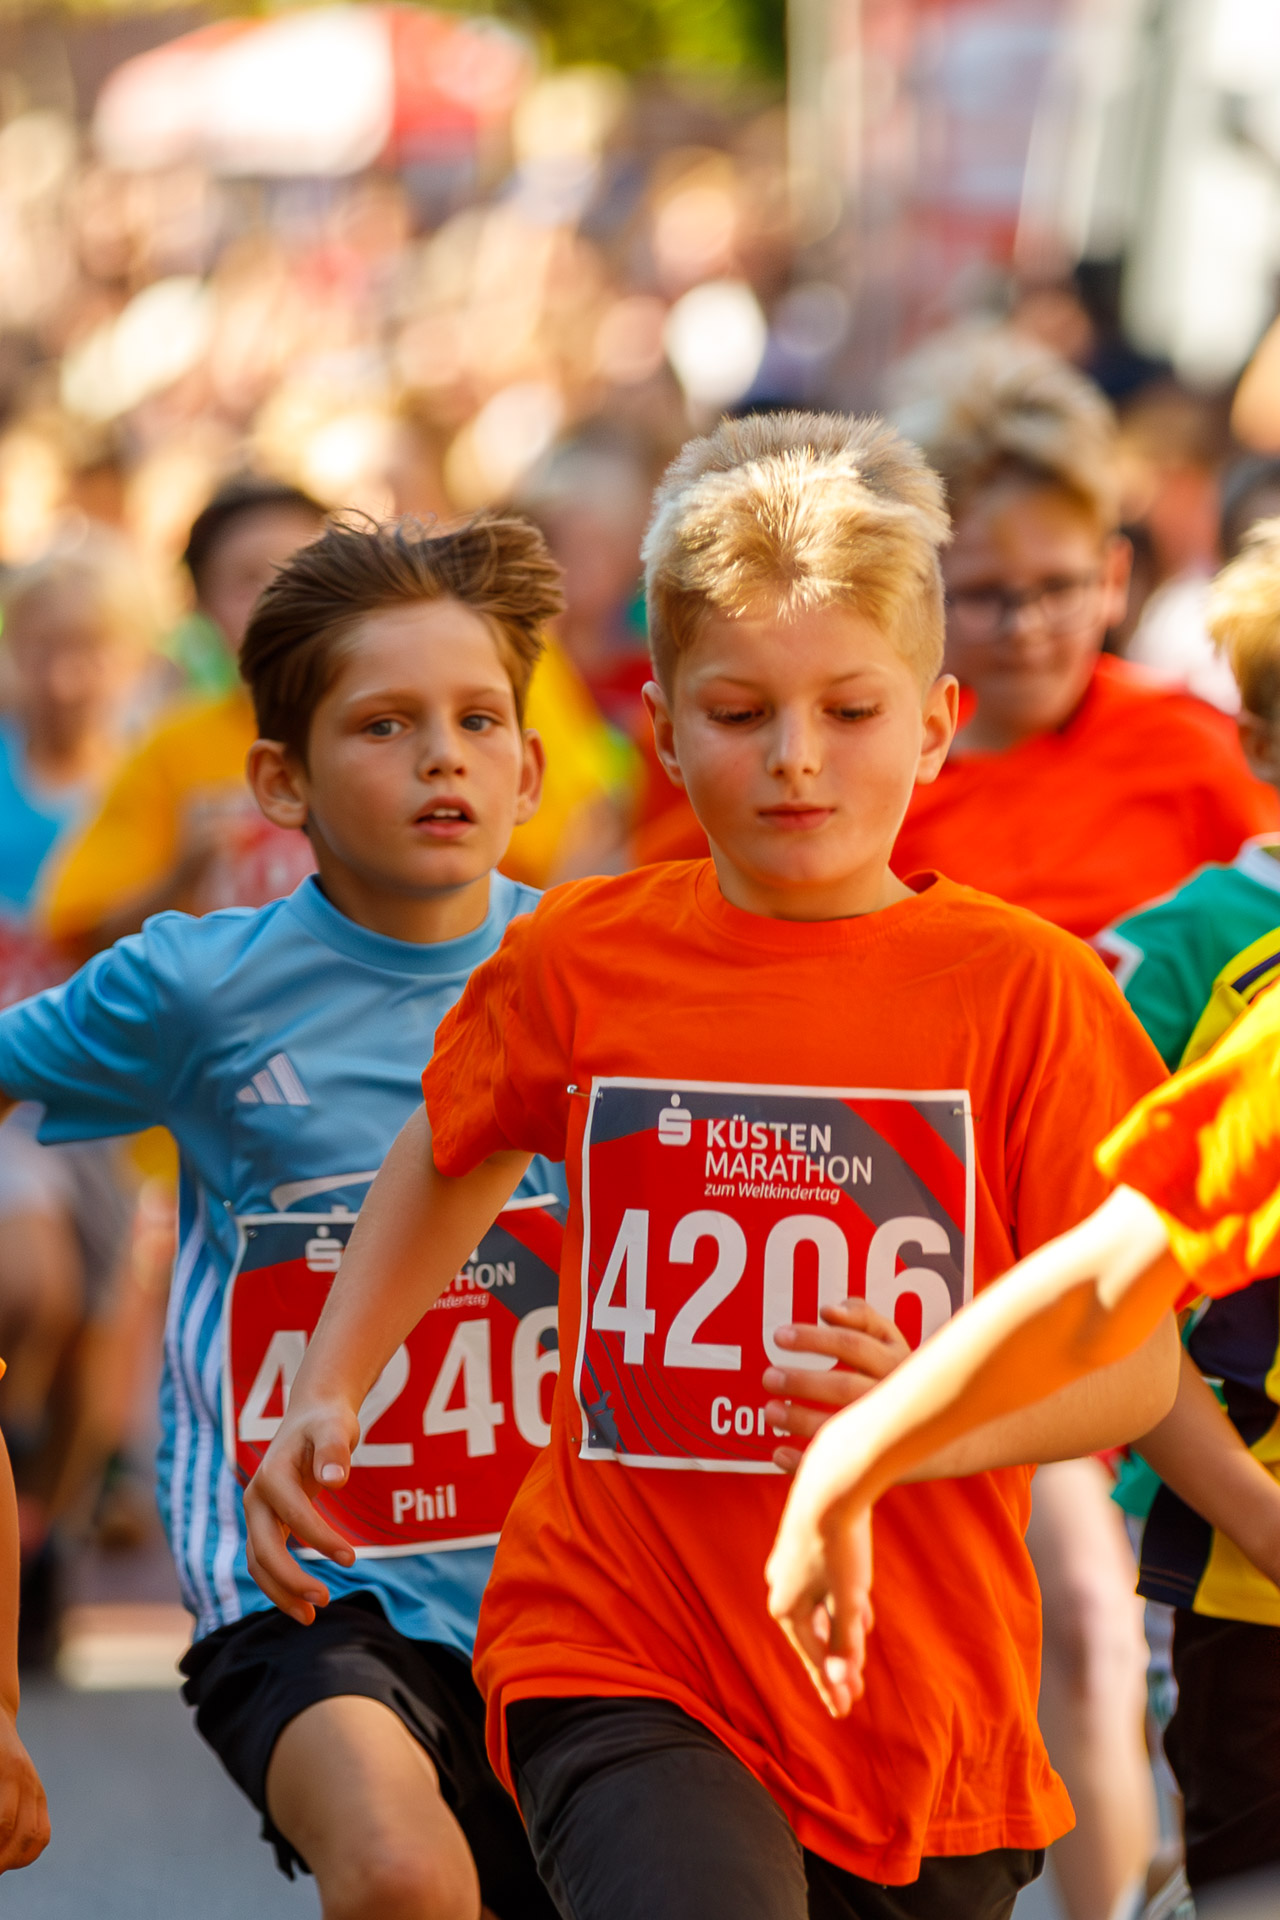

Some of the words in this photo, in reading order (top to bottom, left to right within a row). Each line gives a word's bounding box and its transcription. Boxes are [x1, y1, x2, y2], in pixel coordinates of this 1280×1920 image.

[706, 1114, 831, 1153] KÜSTEN
[705, 1150, 872, 1185] MARATHON
[704, 1183, 735, 1197] zum
[738, 1183, 841, 1205] Weltkindertag
[592, 1209, 952, 1372] 4206
[392, 1483, 457, 1524] Phil
